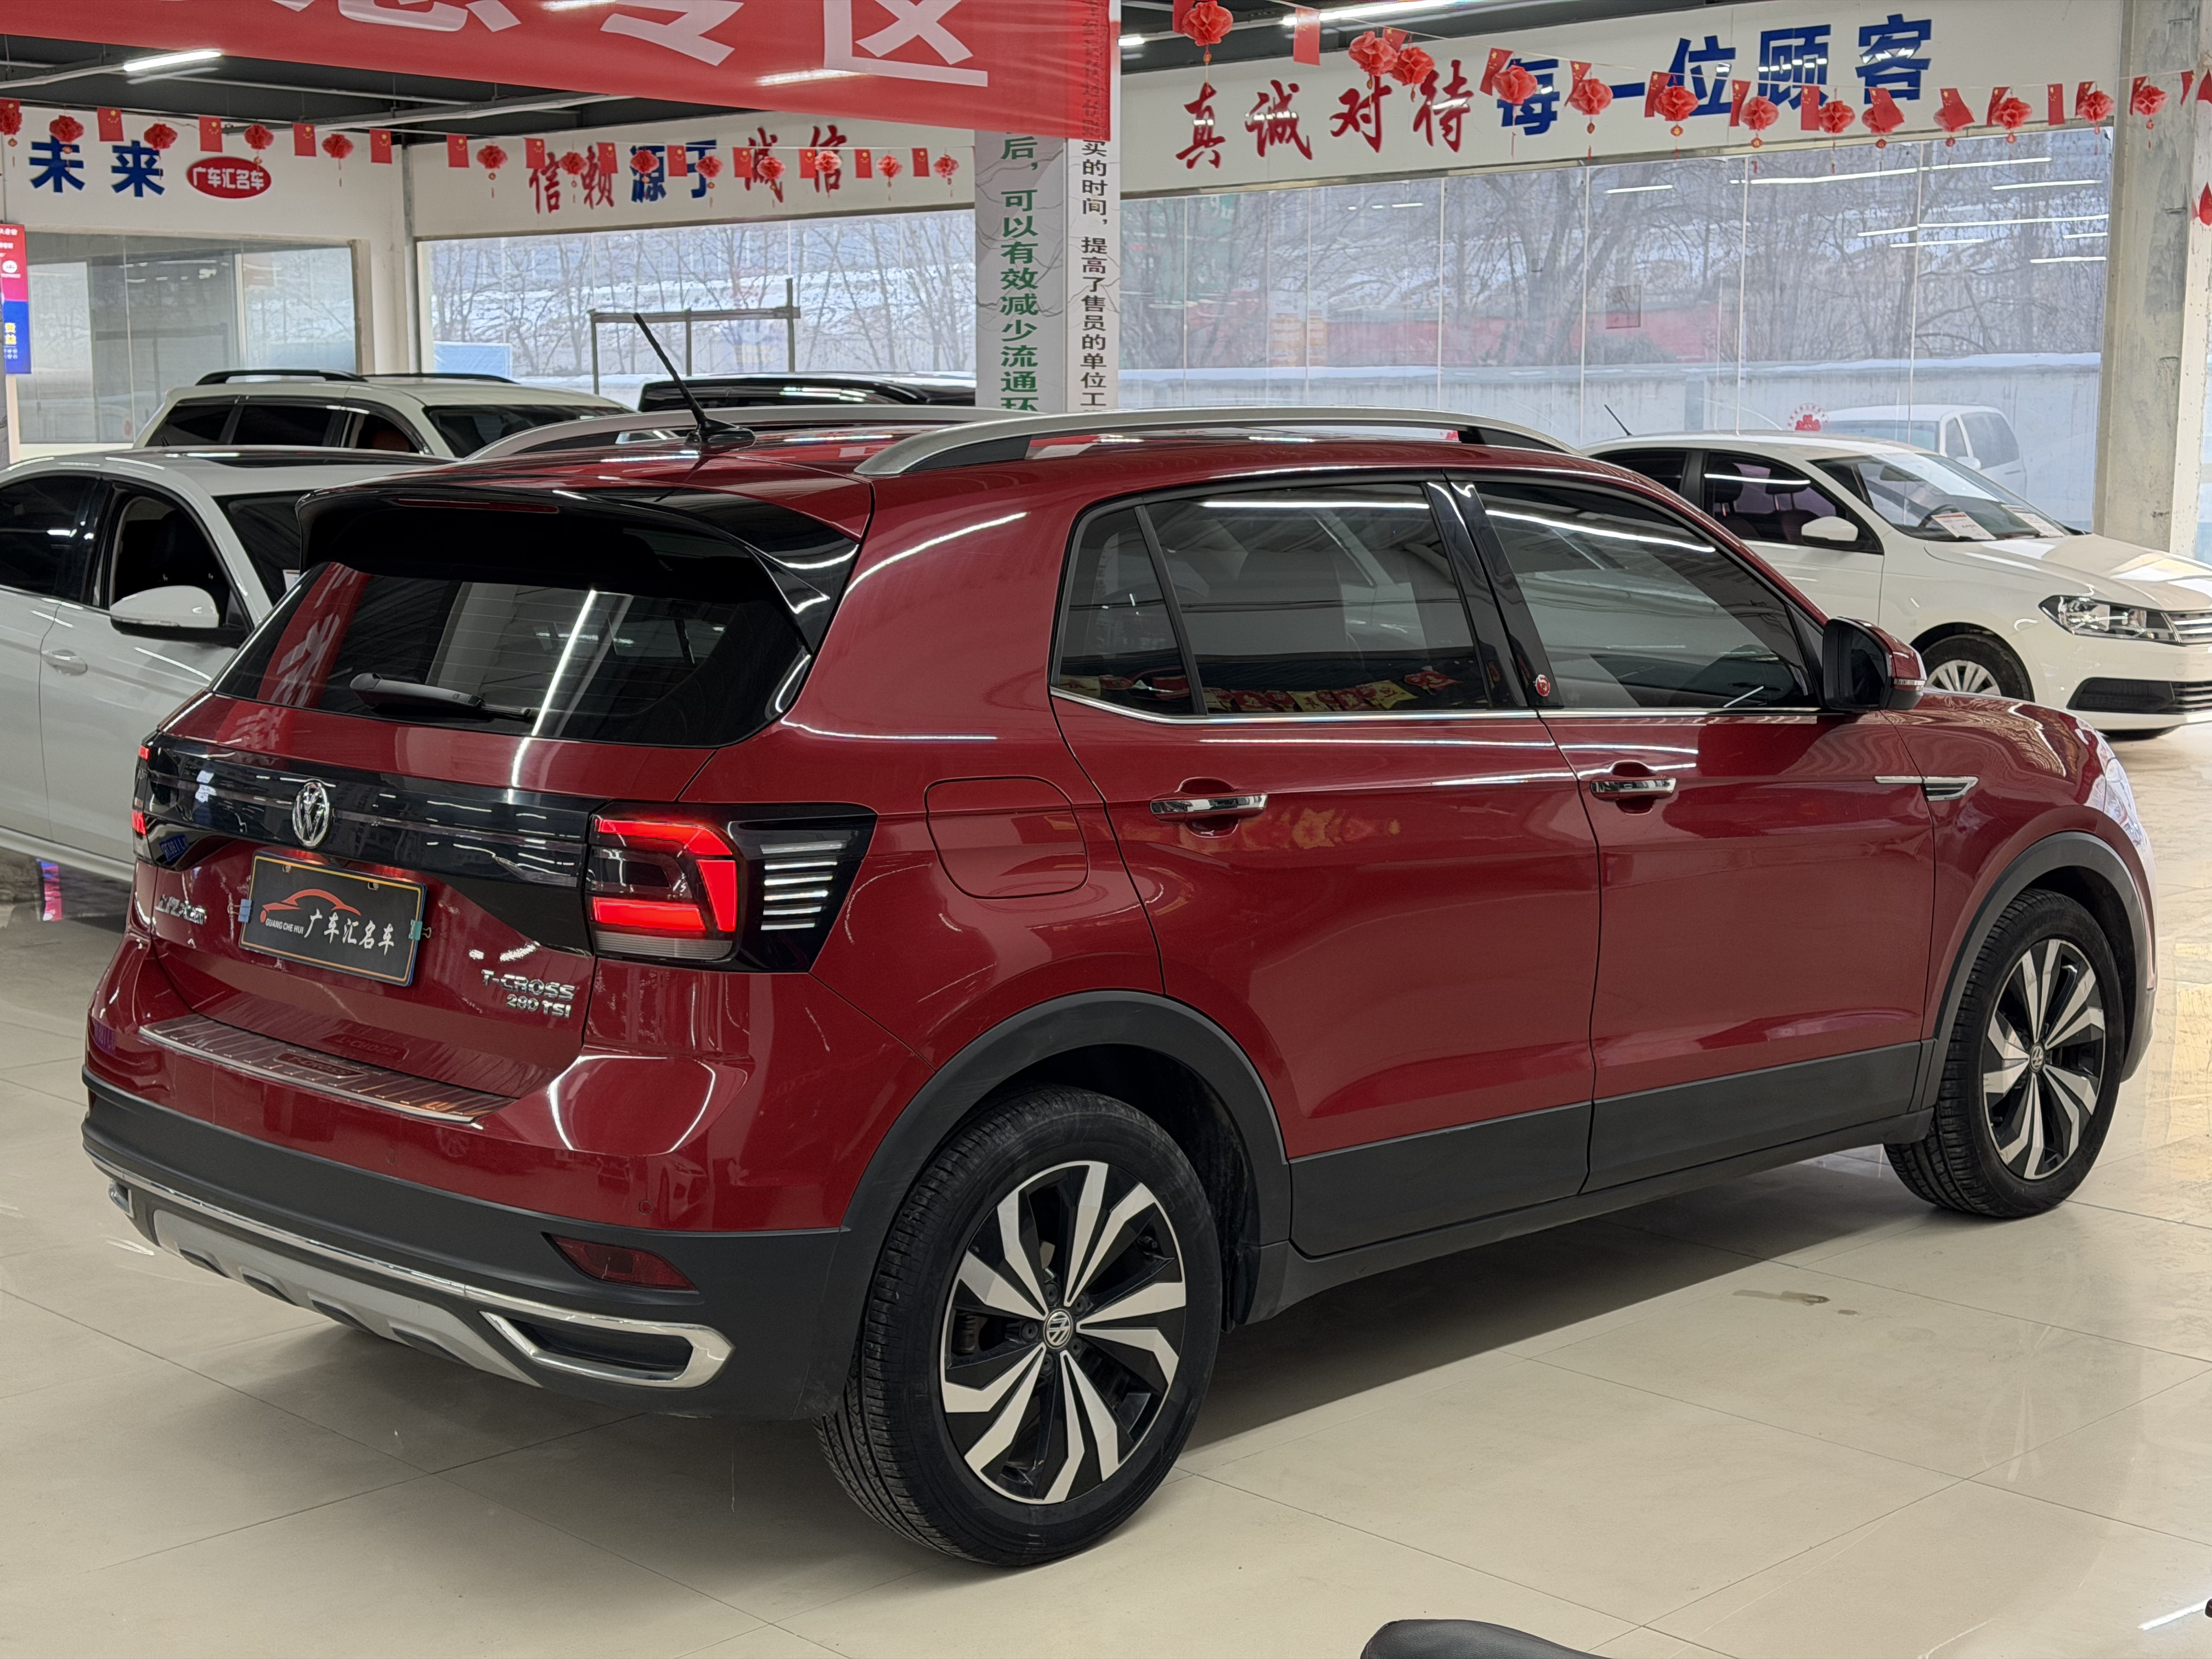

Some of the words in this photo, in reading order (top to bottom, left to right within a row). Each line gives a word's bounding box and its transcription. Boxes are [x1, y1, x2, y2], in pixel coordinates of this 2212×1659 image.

[29, 135, 165, 198] 未来
[193, 167, 264, 190] 广车汇名车
[266, 918, 283, 929] GUANG
[283, 922, 293, 933] CHE
[294, 924, 304, 934] HUI
[304, 909, 394, 956] 广车汇名车
[481, 969, 575, 1001] T-CROSS
[506, 994, 539, 1012] 280
[541, 1000, 572, 1019] TSI
